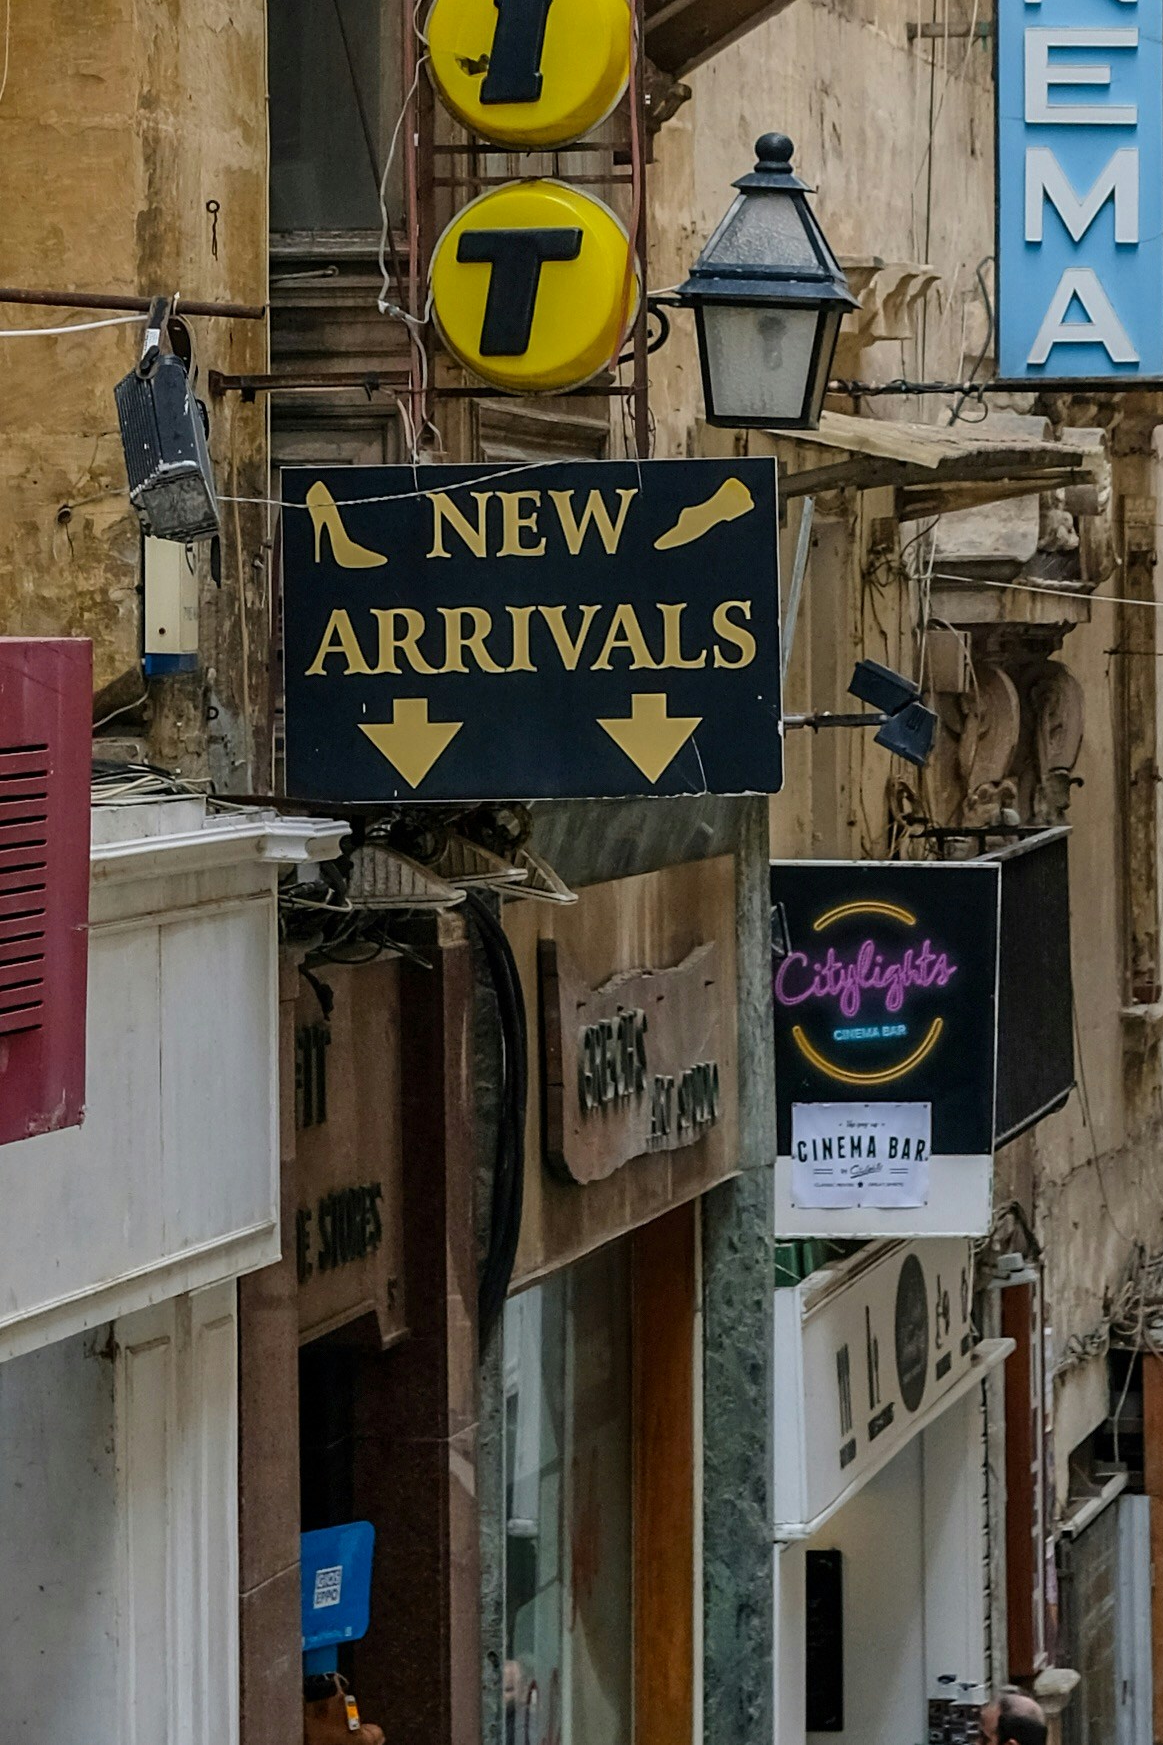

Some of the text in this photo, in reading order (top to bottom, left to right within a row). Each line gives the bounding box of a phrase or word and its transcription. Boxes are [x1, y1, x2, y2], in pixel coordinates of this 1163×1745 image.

[427, 488, 639, 558] NEW
[305, 600, 757, 676] ARRIVALS
[775, 939, 957, 1016] Citylights
[833, 1024, 908, 1042] CINEMA BAR
[797, 1135, 877, 1163] CINEMA
